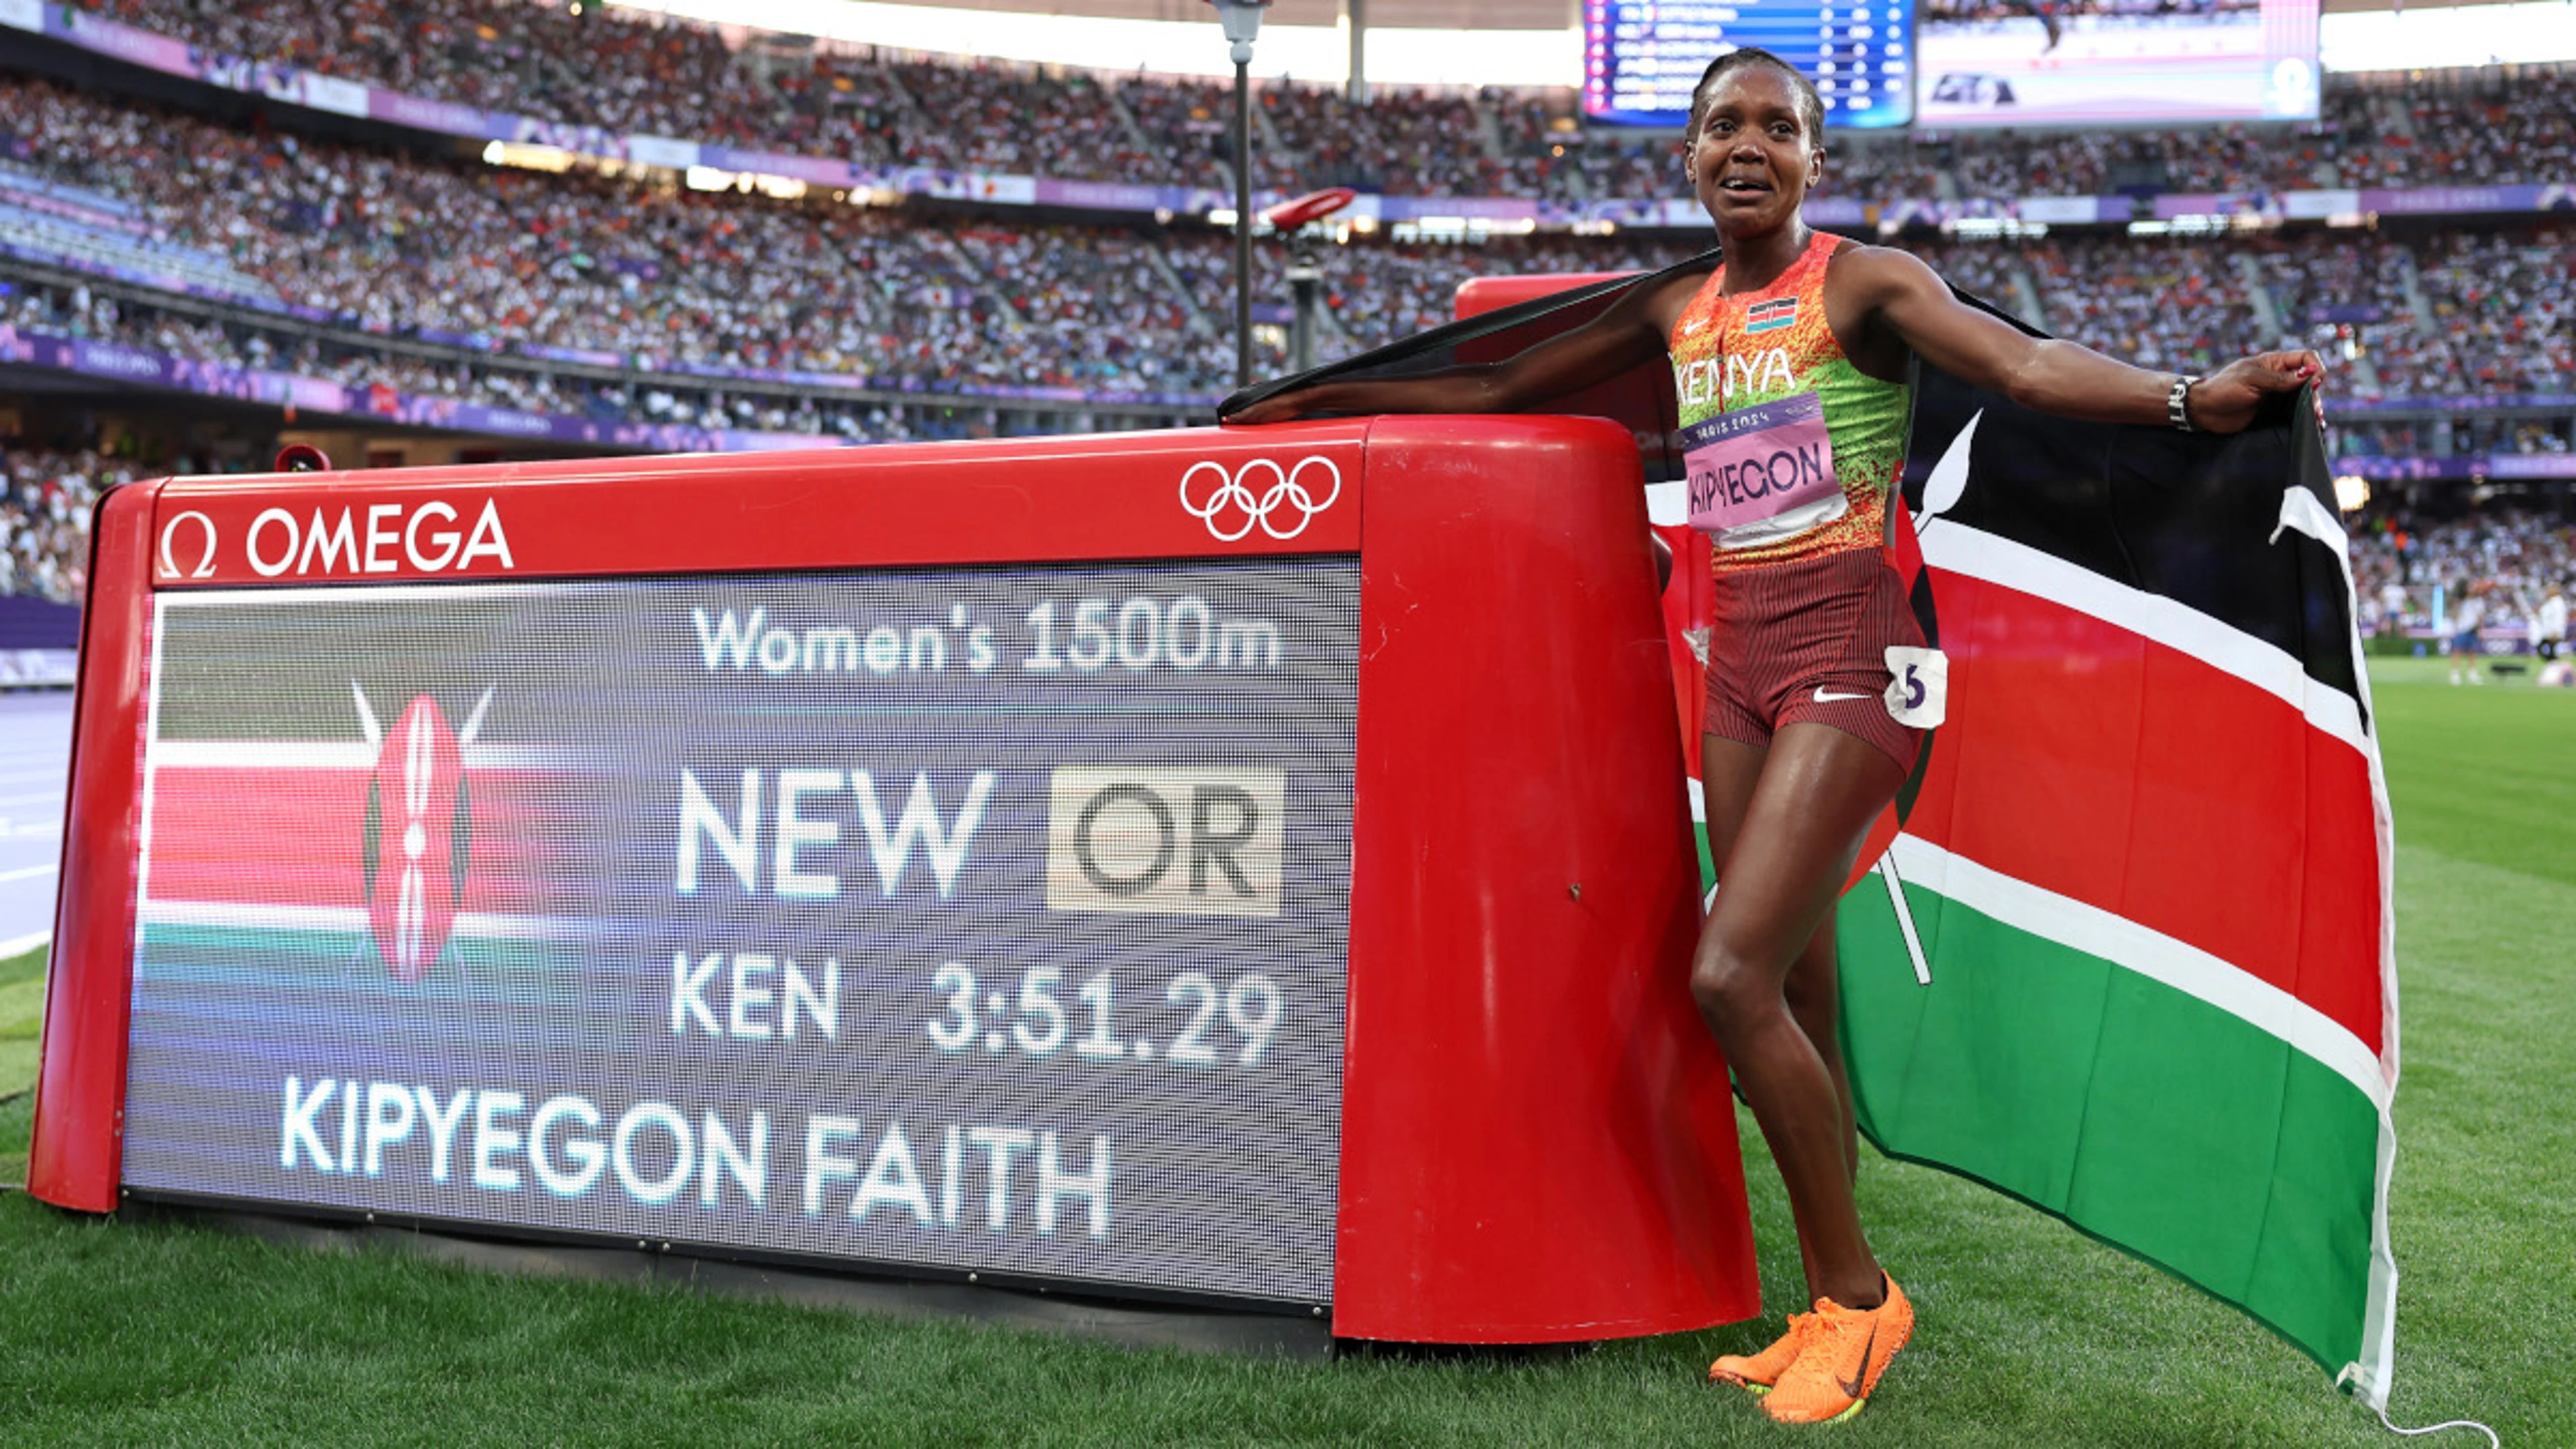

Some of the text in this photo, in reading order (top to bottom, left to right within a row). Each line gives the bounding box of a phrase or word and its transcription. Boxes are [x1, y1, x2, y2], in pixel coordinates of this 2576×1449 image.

[1675, 347, 1796, 407] KENYA
[1732, 411, 1770, 431] 2024
[1688, 441, 1823, 516] KIPYEGON
[246, 497, 515, 577] OMEGA
[692, 597, 1280, 675] Women's 1500m
[675, 767, 1259, 900] NEW OR
[672, 950, 1284, 1067] KEN 3:51.29
[280, 1075, 1114, 1240] KIPYEGON FAITH
